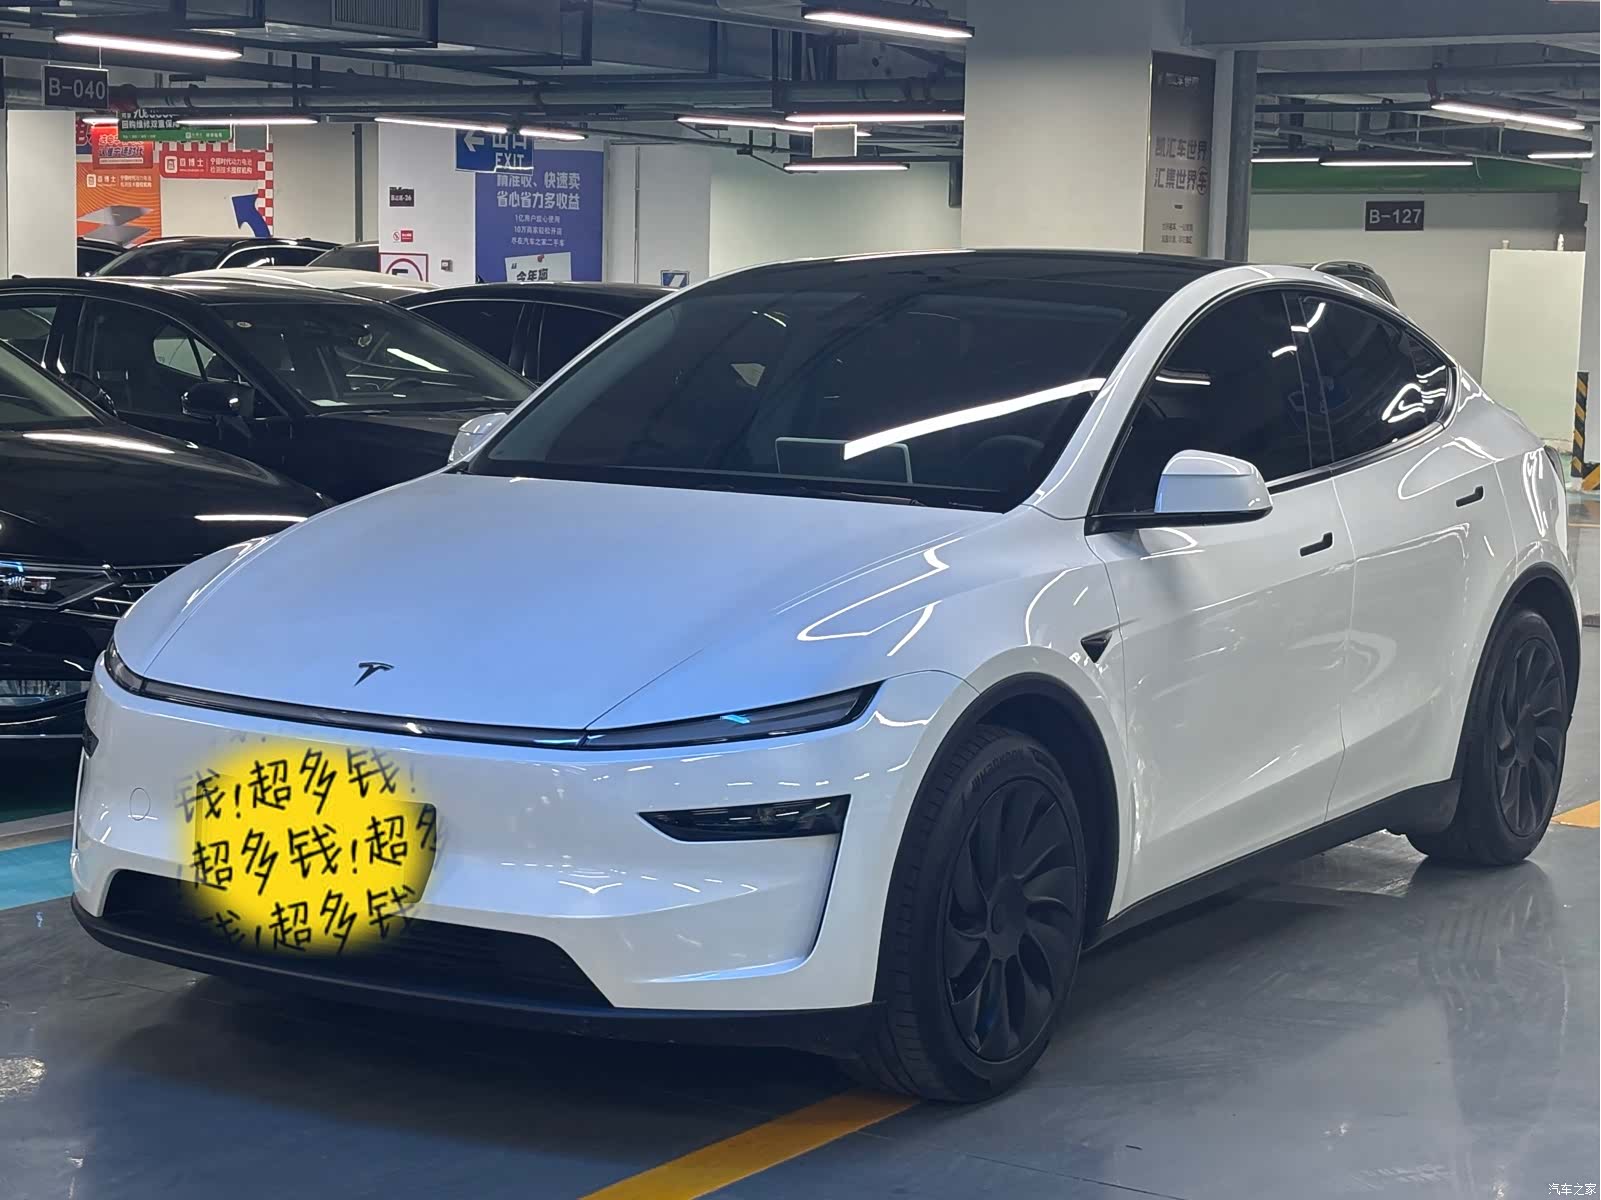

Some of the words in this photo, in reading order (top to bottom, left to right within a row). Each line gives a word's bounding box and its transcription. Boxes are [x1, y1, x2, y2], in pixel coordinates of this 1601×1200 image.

[48, 76, 105, 100] B-040
[1155, 137, 1208, 160] 凯汇车世界
[495, 152, 525, 168] EXIT
[496, 190, 580, 210] 省心省力多收益
[1369, 208, 1422, 224] B-127
